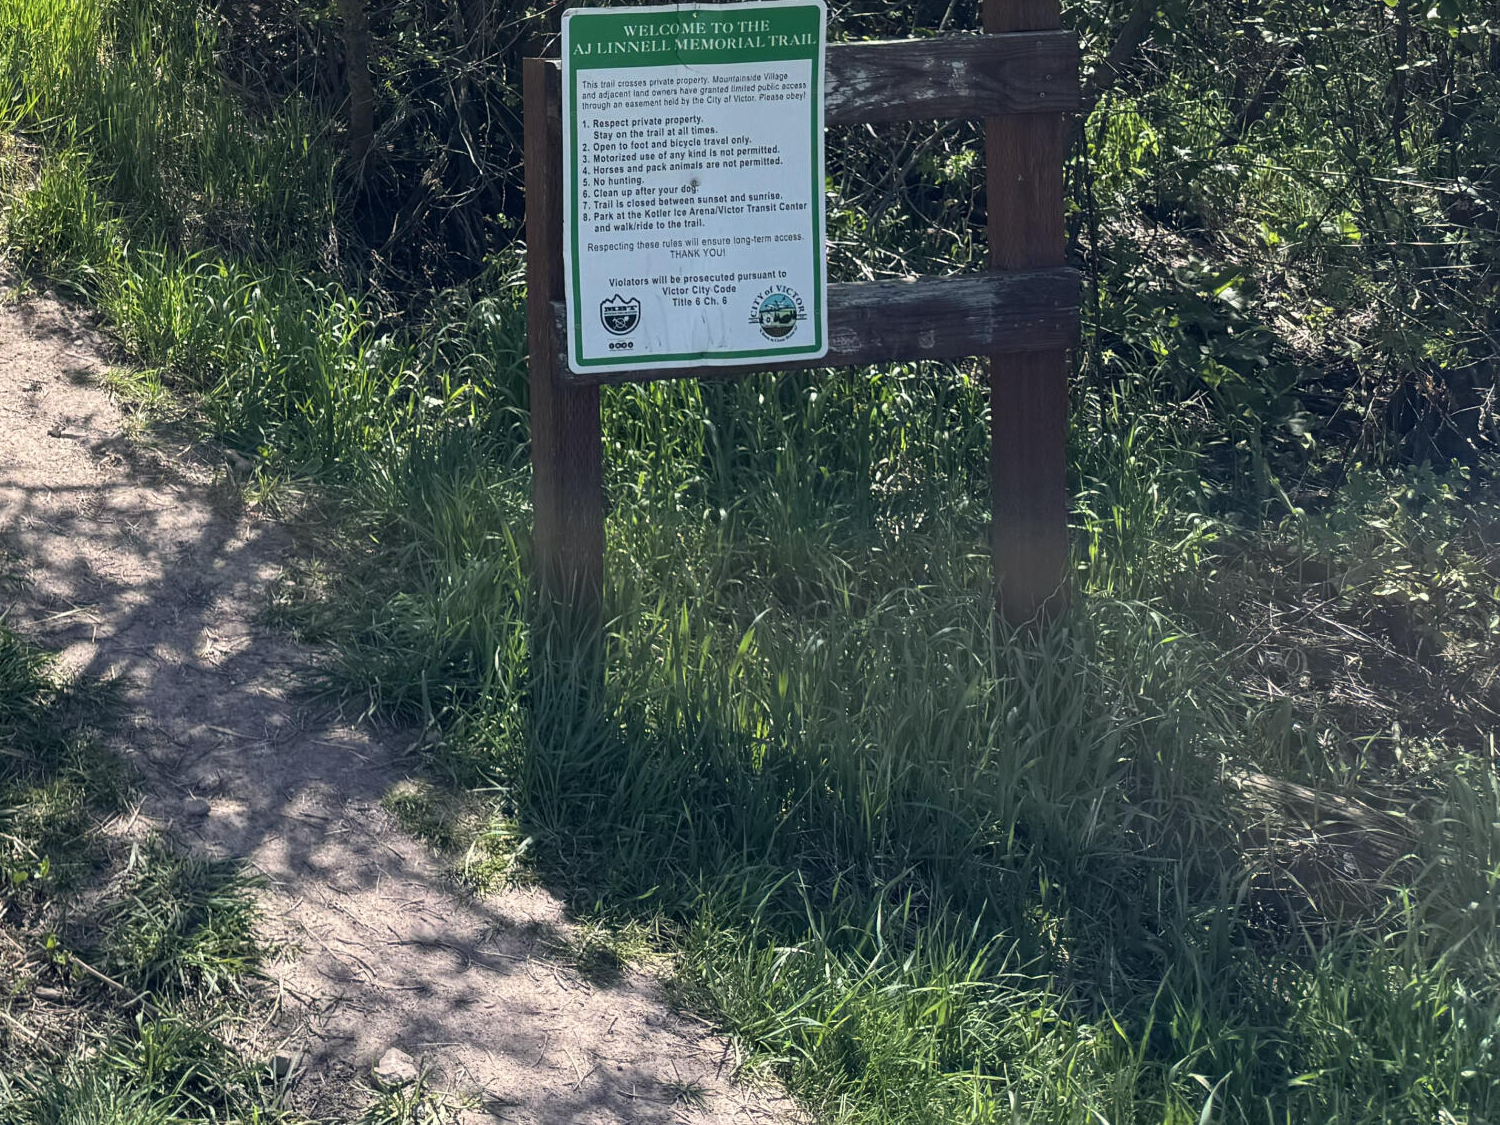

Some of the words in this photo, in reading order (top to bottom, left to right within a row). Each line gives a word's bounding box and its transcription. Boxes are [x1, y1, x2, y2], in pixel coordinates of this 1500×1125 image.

[623, 22, 706, 37] WELCOME
[710, 21, 733, 34] TO
[737, 19, 769, 33] THE
[573, 42, 591, 55] AJ
[597, 39, 670, 54] LINNELL
[674, 35, 765, 51] MEMORIAL
[767, 32, 815, 47] TRAIL
[592, 118, 628, 130] Respect
[631, 116, 662, 129] private
[664, 114, 703, 127] property.
[593, 130, 612, 142] Stay
[629, 129, 643, 138] the
[646, 128, 664, 138] trail
[667, 128, 675, 137] at
[677, 127, 688, 136] all
[691, 126, 717, 136] times.
[592, 141, 616, 153] Open
[618, 141, 628, 150] to
[630, 140, 648, 149] foot
[651, 139, 667, 148] and
[669, 137, 701, 150] bicycle
[703, 136, 728, 146] travel
[731, 135, 751, 146] only.
[593, 152, 636, 163] Motorized
[639, 153, 655, 161] use
[657, 150, 667, 160] of
[669, 152, 685, 161] any
[687, 149, 706, 158] kind
[709, 148, 717, 157] is
[719, 147, 734, 157] not
[736, 145, 779, 158] permitted.
[593, 164, 624, 174] Horses
[626, 163, 643, 172] and
[645, 161, 666, 173] pack
[669, 160, 703, 170] animals
[722, 158, 736, 167] not
[739, 156, 782, 169] permitted.
[593, 177, 605, 186] No
[608, 176, 644, 188] hunting.
[593, 188, 618, 198] Clean
[621, 189, 632, 198] up
[635, 186, 655, 196] after
[658, 187, 678, 196] your
[680, 184, 699, 195] dog.
[593, 200, 613, 210] Trail
[615, 200, 623, 209] is
[626, 198, 655, 208] closed
[658, 196, 694, 207] between
[697, 194, 727, 205] sunset
[730, 193, 745, 203] and
[748, 191, 782, 202] sunrise.
[593, 212, 613, 221] Park
[616, 211, 625, 220] at
[627, 210, 641, 220] the
[673, 208, 686, 218] Ice
[747, 203, 776, 214] Transit
[778, 201, 807, 212] Center
[594, 223, 610, 233] and
[613, 221, 653, 232] walk/ride
[656, 220, 665, 229] to
[667, 220, 681, 229] the
[684, 218, 704, 228] trail.
[587, 241, 634, 254] Respecting
[636, 240, 659, 249] these
[662, 239, 682, 248] rules
[684, 238, 698, 247] will
[701, 238, 730, 246] ensure
[733, 234, 771, 247] long-term
[774, 235, 804, 243] access.
[670, 249, 700, 259] THANK
[703, 249, 725, 258] YOU!
[608, 277, 649, 287] Violators
[651, 276, 667, 285] will
[669, 275, 680, 285] be
[683, 272, 735, 286] prosecuted
[737, 270, 775, 283] pursuant
[777, 269, 787, 278] to
[662, 286, 688, 295] Victor
[691, 285, 710, 296] City
[713, 284, 736, 294] Code
[776, 284, 805, 313] VICTOR
[672, 297, 692, 306] Title
[703, 296, 718, 305] Ch.
